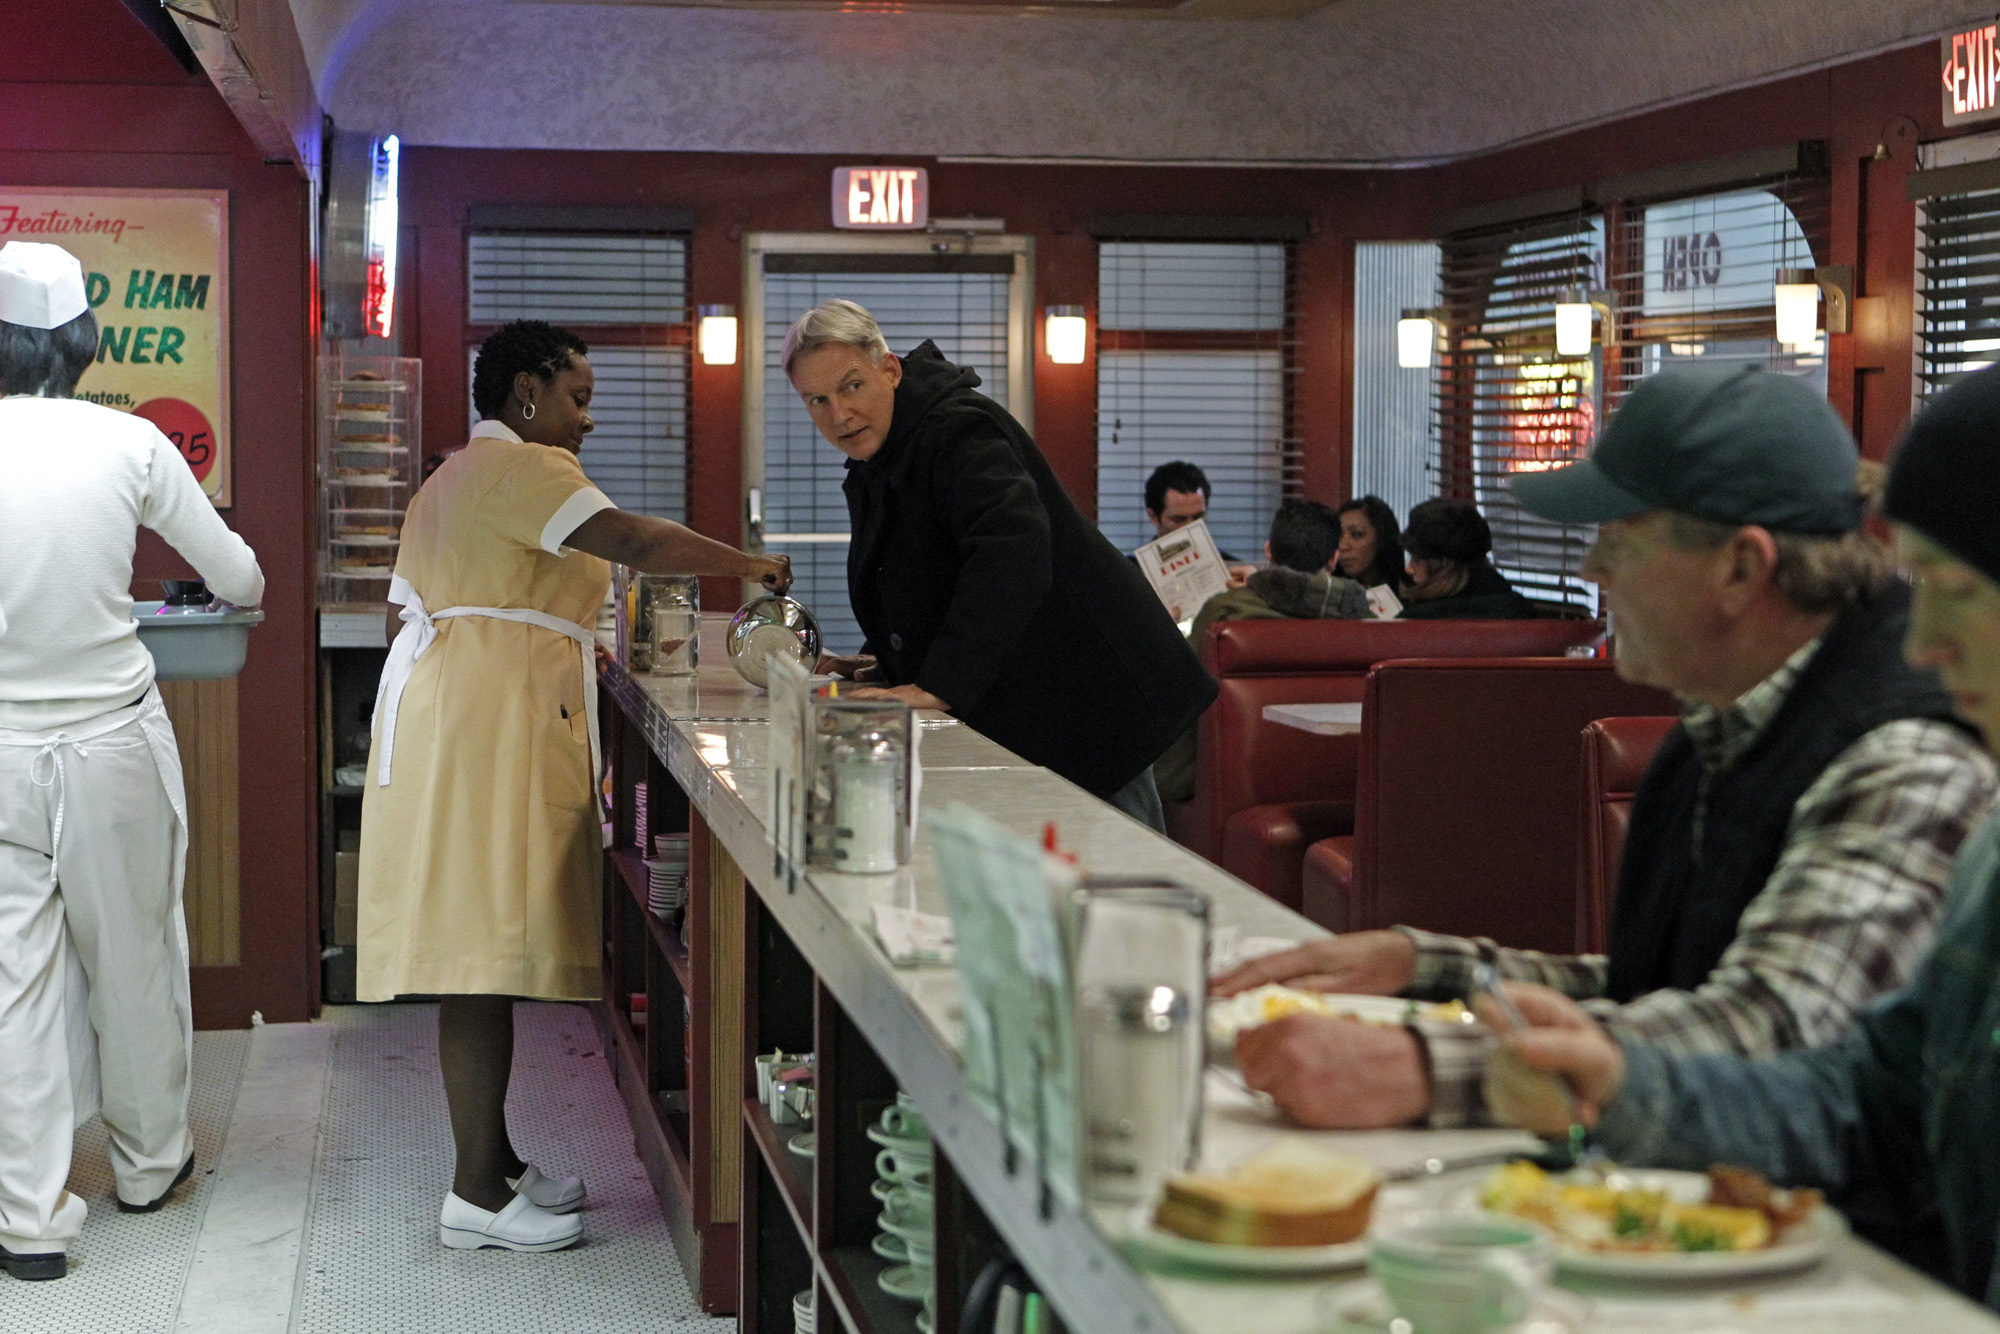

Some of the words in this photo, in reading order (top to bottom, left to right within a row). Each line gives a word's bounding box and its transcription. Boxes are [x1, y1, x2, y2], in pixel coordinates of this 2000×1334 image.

[1952, 25, 1997, 115] EXIT
[848, 169, 919, 224] EXIT
[82, 271, 111, 309] D
[124, 269, 211, 310] HAM
[96, 326, 186, 364] NER
[75, 391, 136, 408] otatoes,
